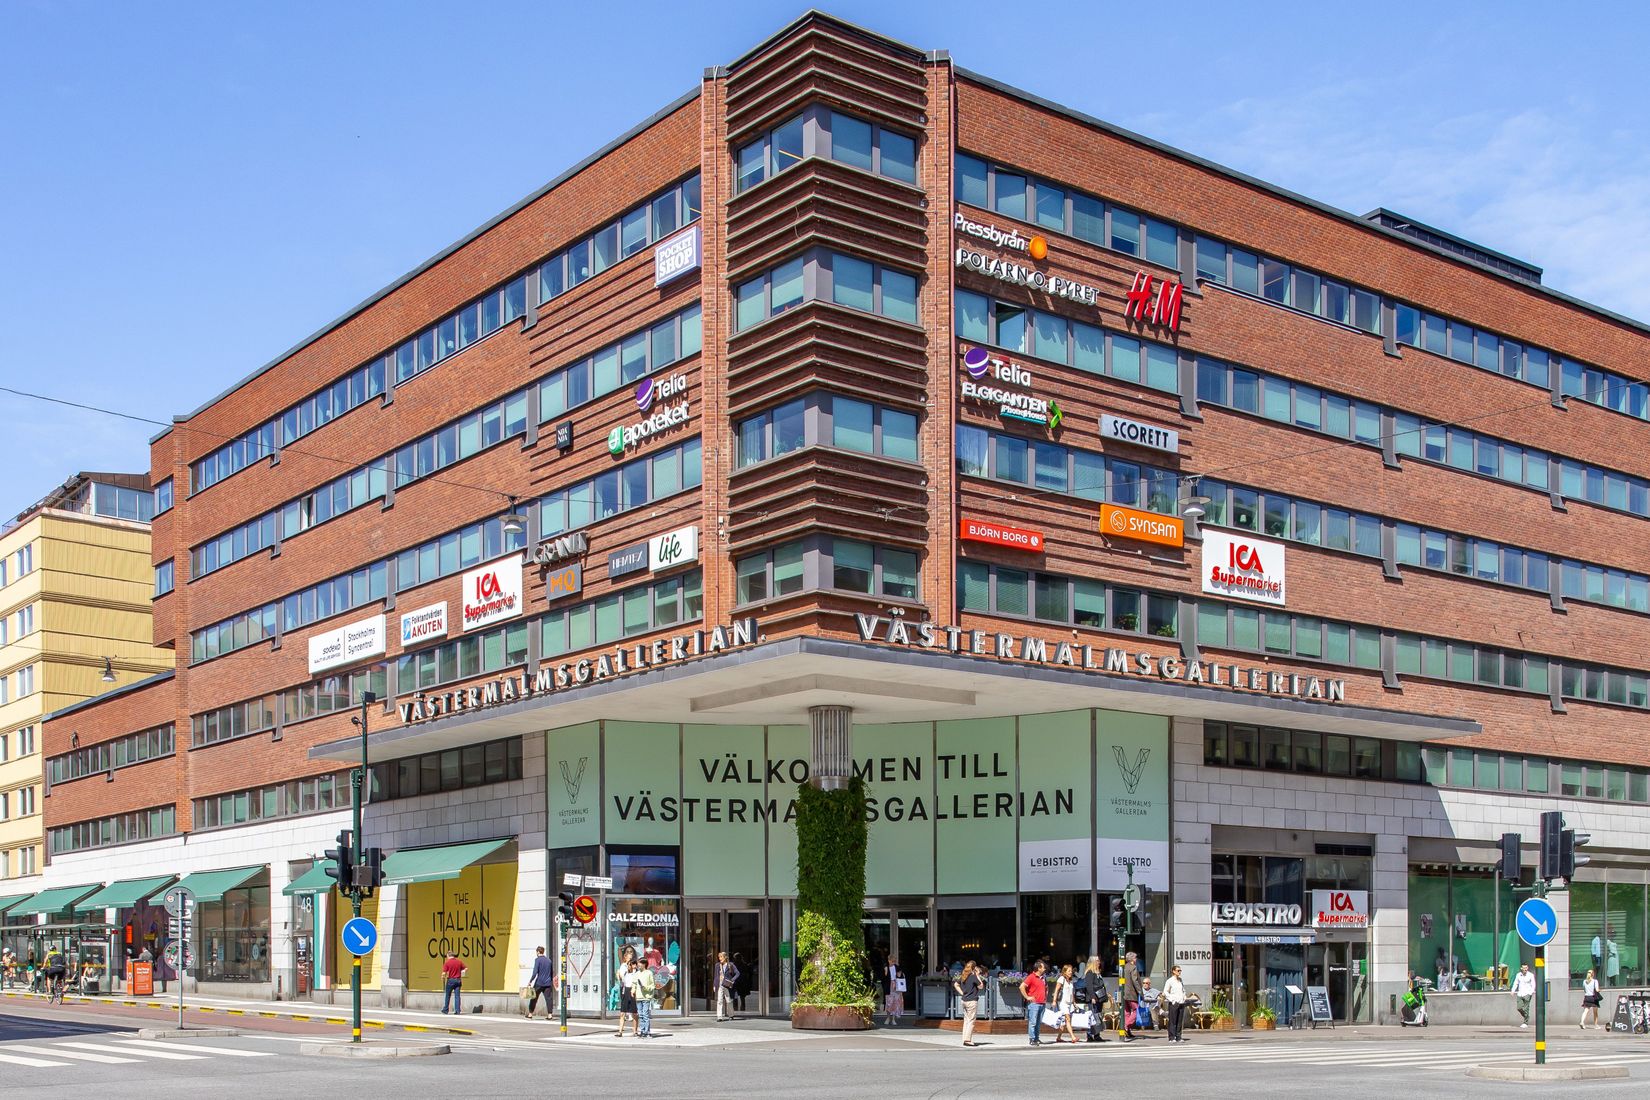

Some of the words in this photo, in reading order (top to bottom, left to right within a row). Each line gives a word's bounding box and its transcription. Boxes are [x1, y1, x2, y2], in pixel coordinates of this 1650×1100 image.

[954, 212, 1025, 250] Pressbyrån
[659, 235, 692, 259] POCKET
[659, 247, 693, 277] SHOP
[957, 249, 1028, 286] POLARN
[1050, 277, 1099, 305] PYRET
[1124, 270, 1184, 332] H&M
[992, 359, 1031, 387] Telia
[656, 374, 687, 399] Telia
[962, 381, 1047, 413] ELGIGANTEN
[623, 400, 690, 446] apoteket
[1113, 419, 1169, 449] SCORETT
[969, 525, 1001, 540] BJÖRN
[1002, 530, 1029, 544] BORG
[1129, 517, 1177, 539] SYNSAM
[1229, 542, 1264, 573] ICA
[476, 571, 501, 600] ICA
[550, 569, 576, 593] MQ
[1211, 566, 1283, 593] Supermarket
[465, 591, 516, 618] Supermarket
[348, 628, 376, 642] Stockholms
[411, 618, 443, 638] AKUTEN
[854, 607, 1346, 702] VÄSTERMALMSGALLERIAN
[398, 617, 758, 724] VÄSTERMALMSGALLERIAN
[699, 752, 922, 784] VÄLKOMEN
[937, 752, 1008, 780] TILL
[613, 788, 1075, 823] VÄSTERMASGALLERIAN
[1110, 797, 1152, 807] VÄSTERMALMS
[1114, 807, 1147, 816] GALLERIAN
[301, 896, 312, 913] 48
[453, 892, 469, 905] THE
[1330, 892, 1355, 911] ICA
[432, 908, 490, 932] ITALIAN
[608, 912, 680, 923] CALZEDONIA
[1211, 902, 1302, 925] LeBISTRO
[1317, 911, 1368, 925] Supermarket
[427, 935, 497, 959] COUSINS
